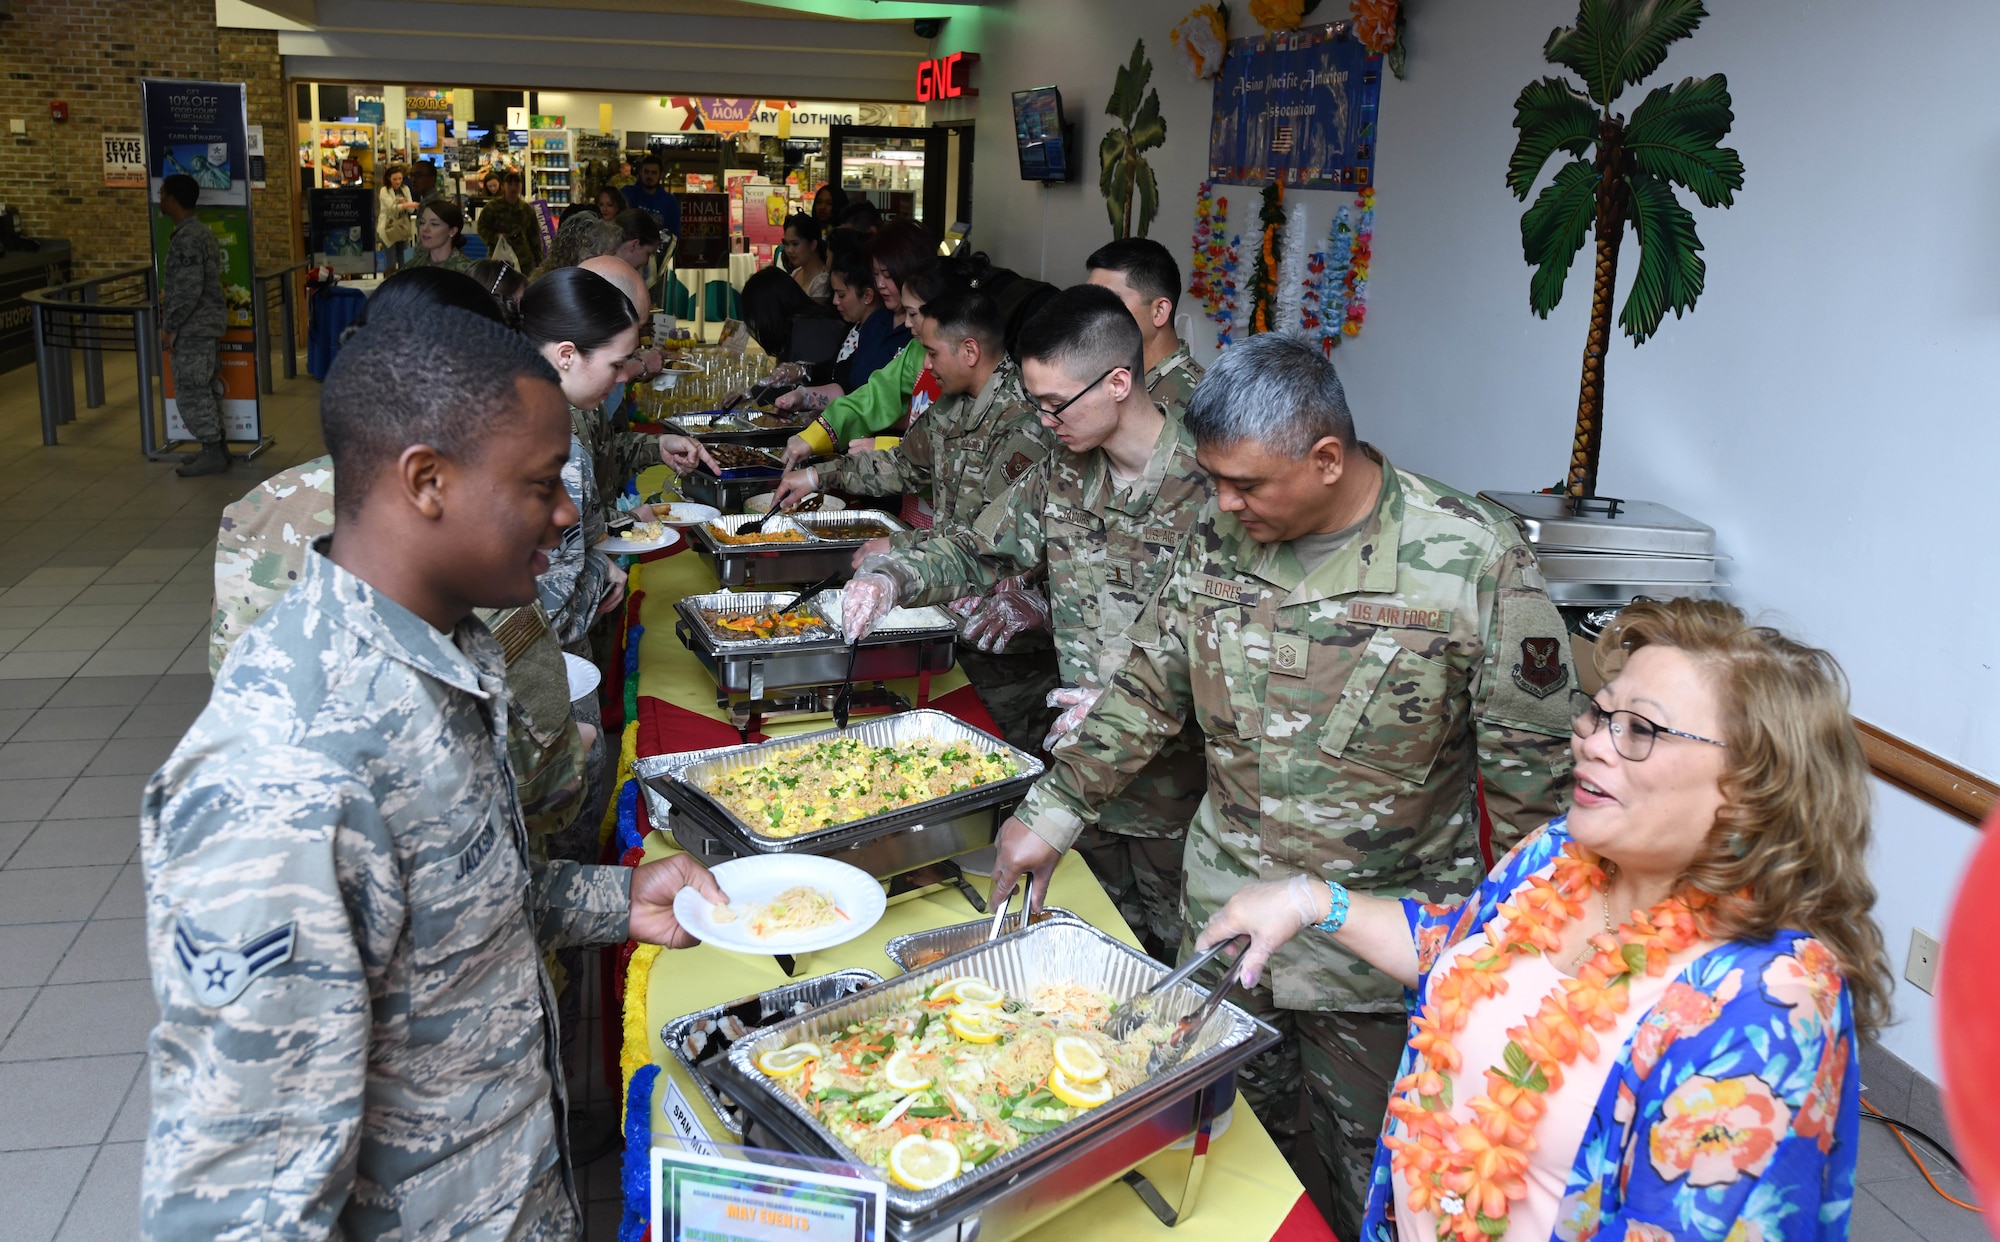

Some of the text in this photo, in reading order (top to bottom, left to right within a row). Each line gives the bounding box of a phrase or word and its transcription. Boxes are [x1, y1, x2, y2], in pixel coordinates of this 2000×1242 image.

[916, 51, 962, 103] GNC
[1232, 69, 1349, 97] Asian Pacific American
[168, 96, 218, 107] 10% OFF
[407, 96, 448, 110] zone
[1259, 100, 1316, 122] Association
[711, 107, 744, 120] MOM
[792, 112, 853, 126] LOTHING
[104, 141, 141, 153] TEXAS
[105, 152, 142, 164] STYLE
[680, 201, 722, 215] FINAL
[745, 198, 766, 206] Event
[533, 203, 550, 234] MILITARY
[1145, 528, 1160, 541] U.S.
[1163, 530, 1175, 544] AIR
[1204, 578, 1242, 600] FLORES
[1351, 604, 1446, 629] U.S. AIR FORCE
[455, 821, 498, 880] JACKSON
[673, 1104, 692, 1137] SPAM
[726, 1203, 810, 1231] MAY EVENTS
